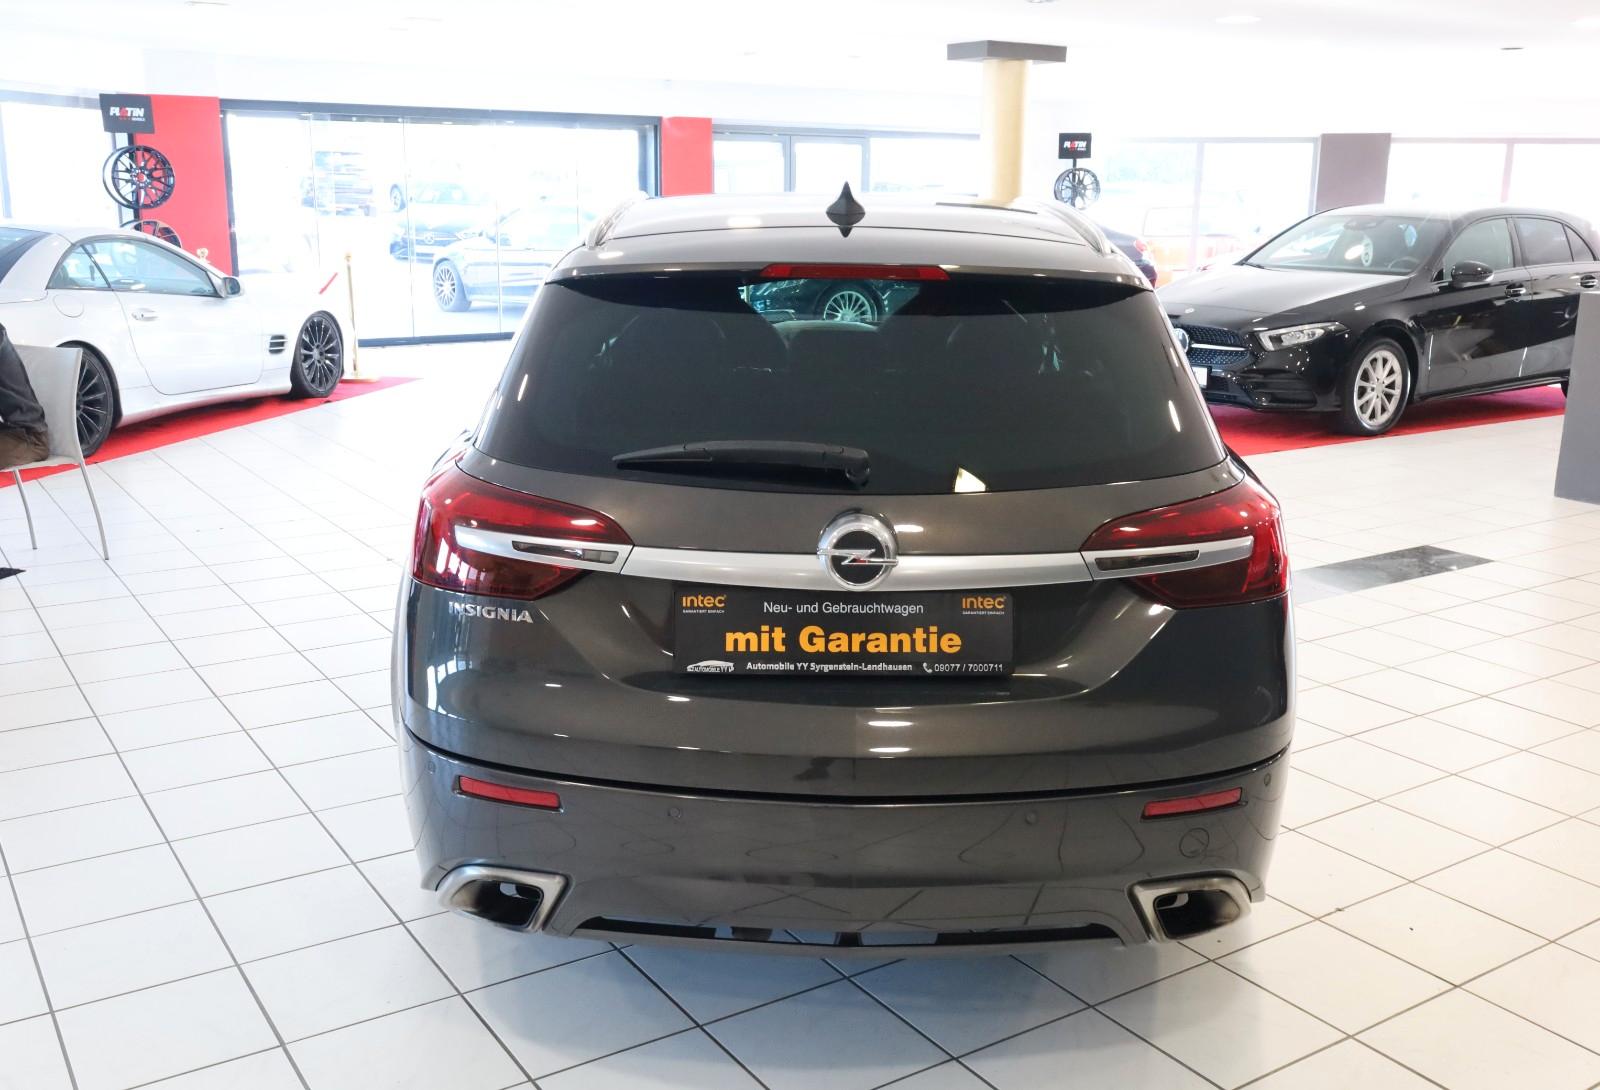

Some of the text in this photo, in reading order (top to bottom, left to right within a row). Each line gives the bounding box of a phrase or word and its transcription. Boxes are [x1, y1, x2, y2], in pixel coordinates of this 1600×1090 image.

[682, 594, 725, 608] intec
[962, 596, 1005, 609] intec
[448, 601, 534, 624] INSIGNIA
[763, 601, 924, 617] Neu- und Gebrauchtwagen
[725, 625, 962, 654] mit Garantie
[746, 661, 913, 673] Automobile YY Syrgenstein-Landhausen
[934, 663, 960, 672] 09077
[968, 663, 1003, 672] 7000711
